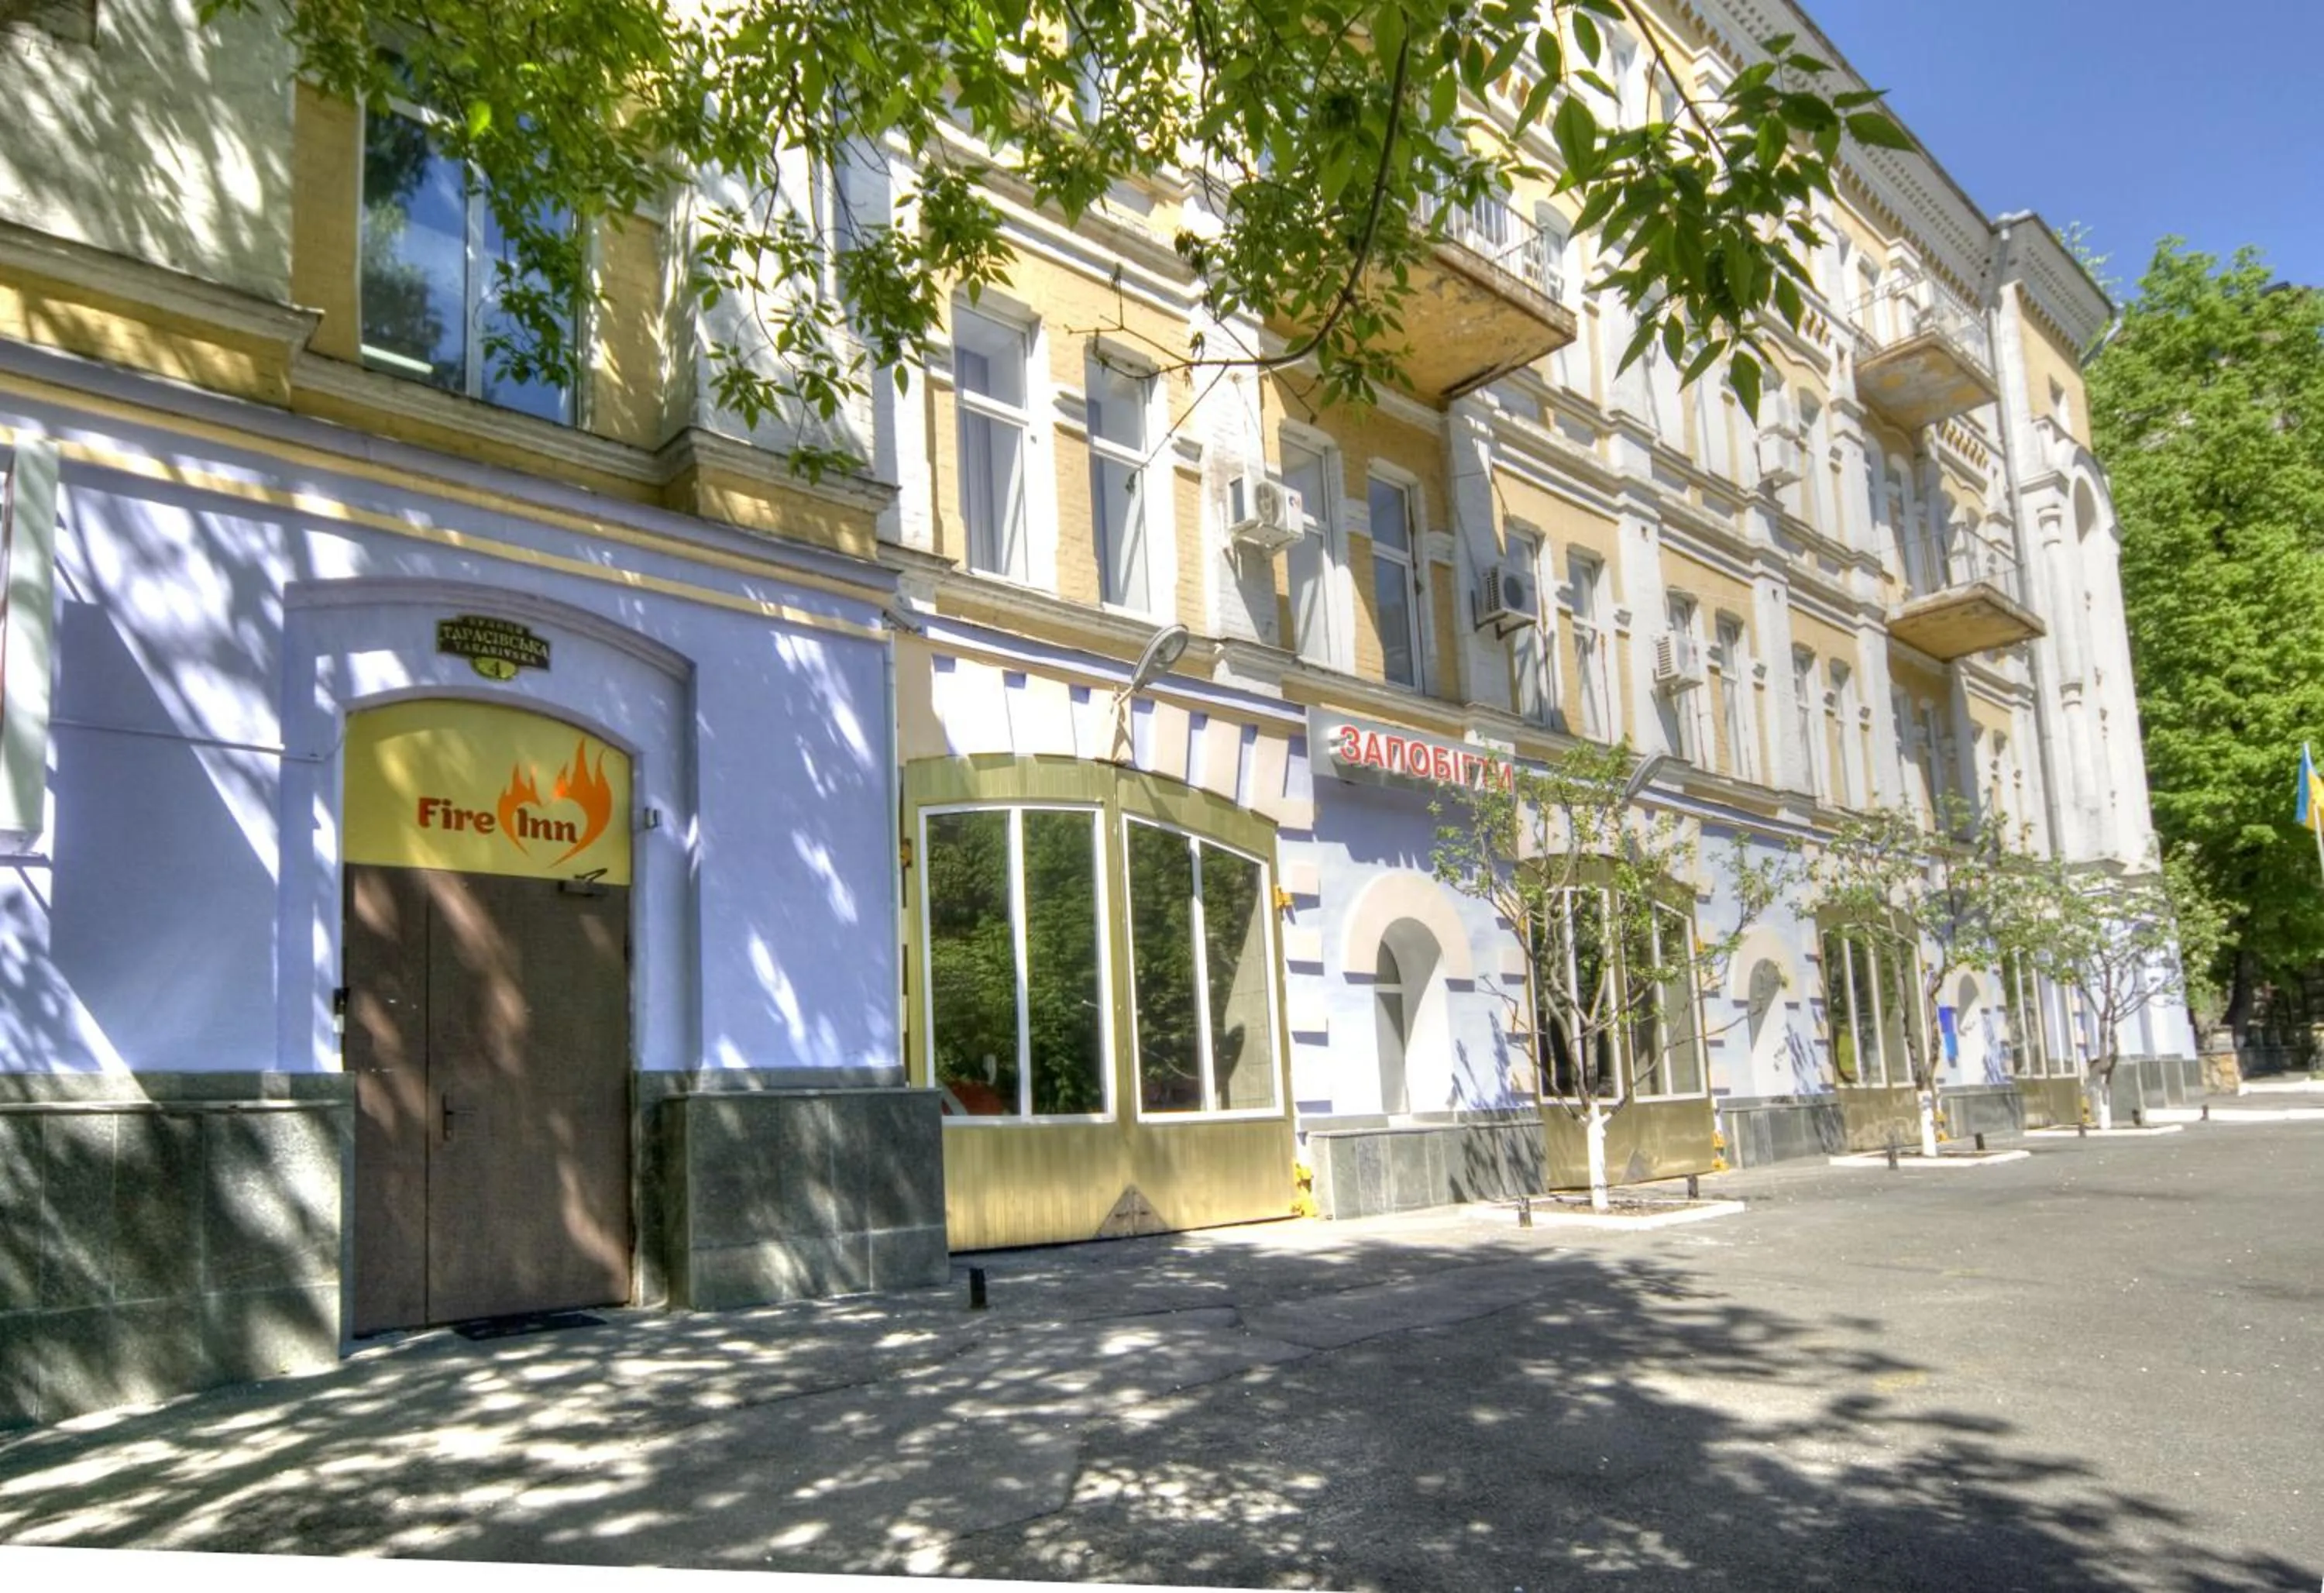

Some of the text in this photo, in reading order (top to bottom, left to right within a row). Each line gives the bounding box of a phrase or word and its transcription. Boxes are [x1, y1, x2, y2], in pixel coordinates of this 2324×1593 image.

[442, 625, 549, 658] ТАРАСІВСЬКА
[1339, 724, 1514, 792] ЗАПОБІГТИ
[418, 796, 577, 844] Fire Inn
